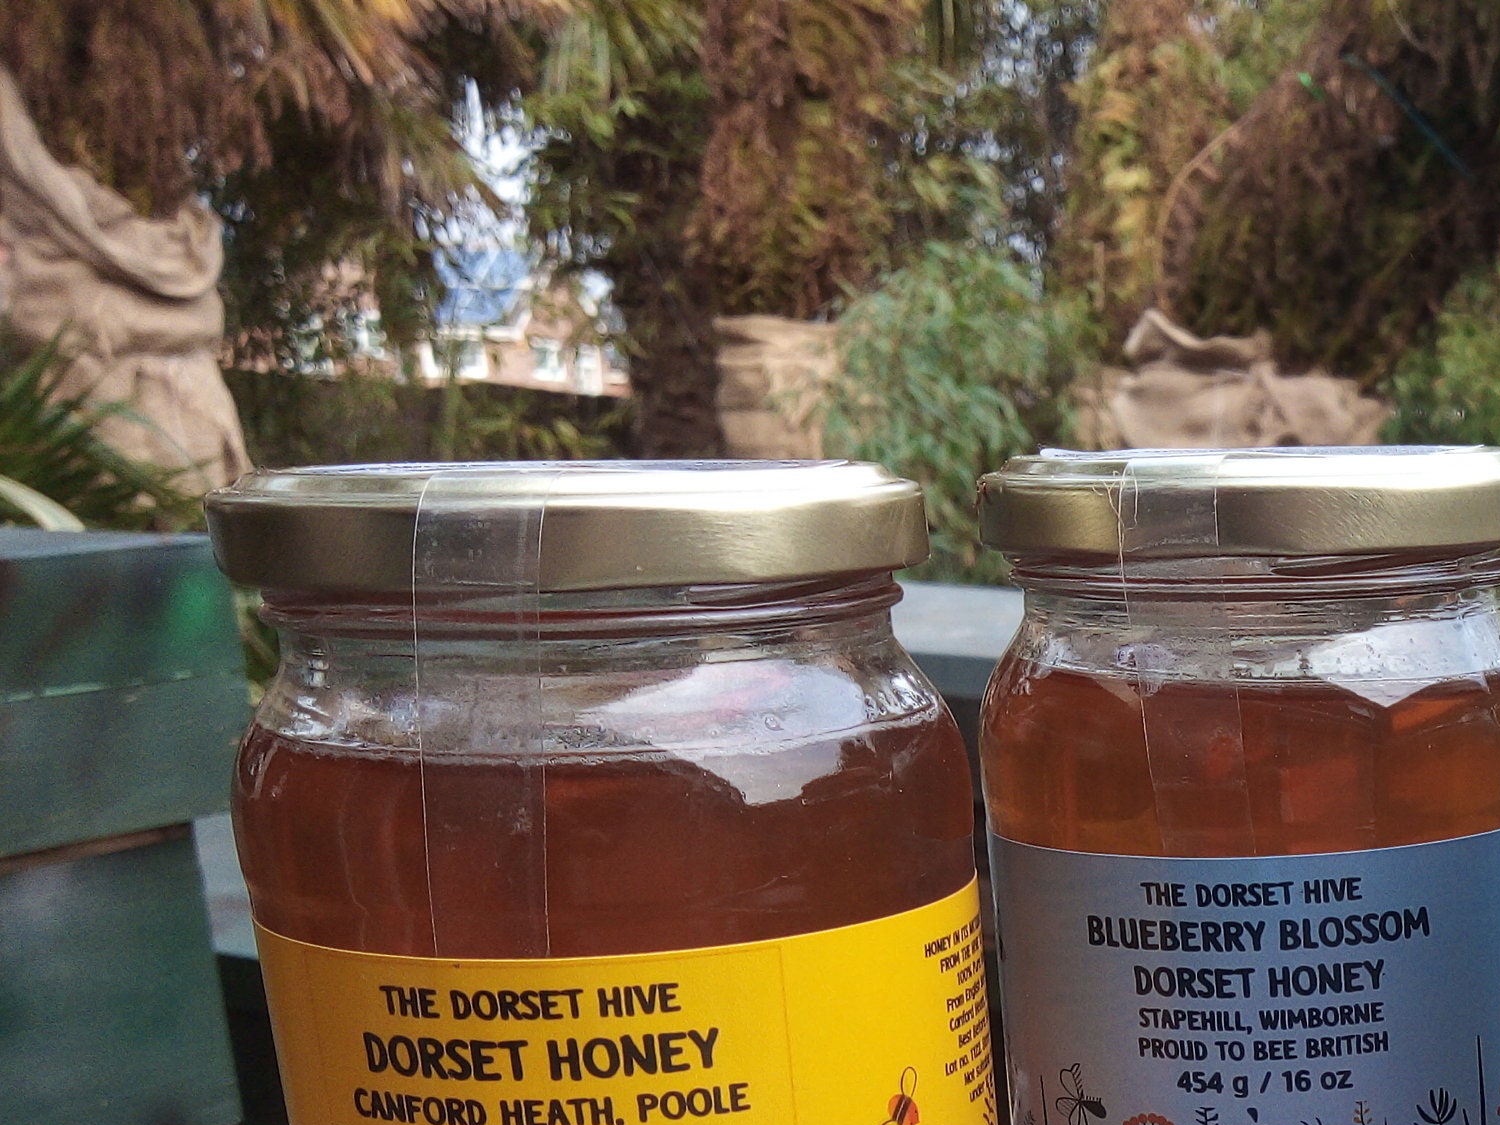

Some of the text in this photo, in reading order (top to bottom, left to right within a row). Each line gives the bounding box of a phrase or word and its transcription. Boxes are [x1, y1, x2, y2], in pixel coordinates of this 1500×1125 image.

[1140, 877, 1362, 908] THE DORSET HIVE
[924, 934, 951, 958] HONEY
[1088, 907, 1430, 953] BLUEBERRY BLOSSOM
[940, 951, 960, 973] FROM
[1134, 959, 1384, 999] DORSET HONEY
[379, 983, 681, 1022] THE DORSET HIVE
[1139, 1002, 1384, 1035] STAPEHILL, WIMBORNE
[363, 1028, 718, 1082] DORSET HONEY
[1139, 1031, 1388, 1062] PROUD TO BEE BRITISH
[945, 1062, 957, 1077] Lot
[1177, 1069, 1353, 1099] 454 g / 16 oz
[637, 1083, 750, 1123] POOLE
